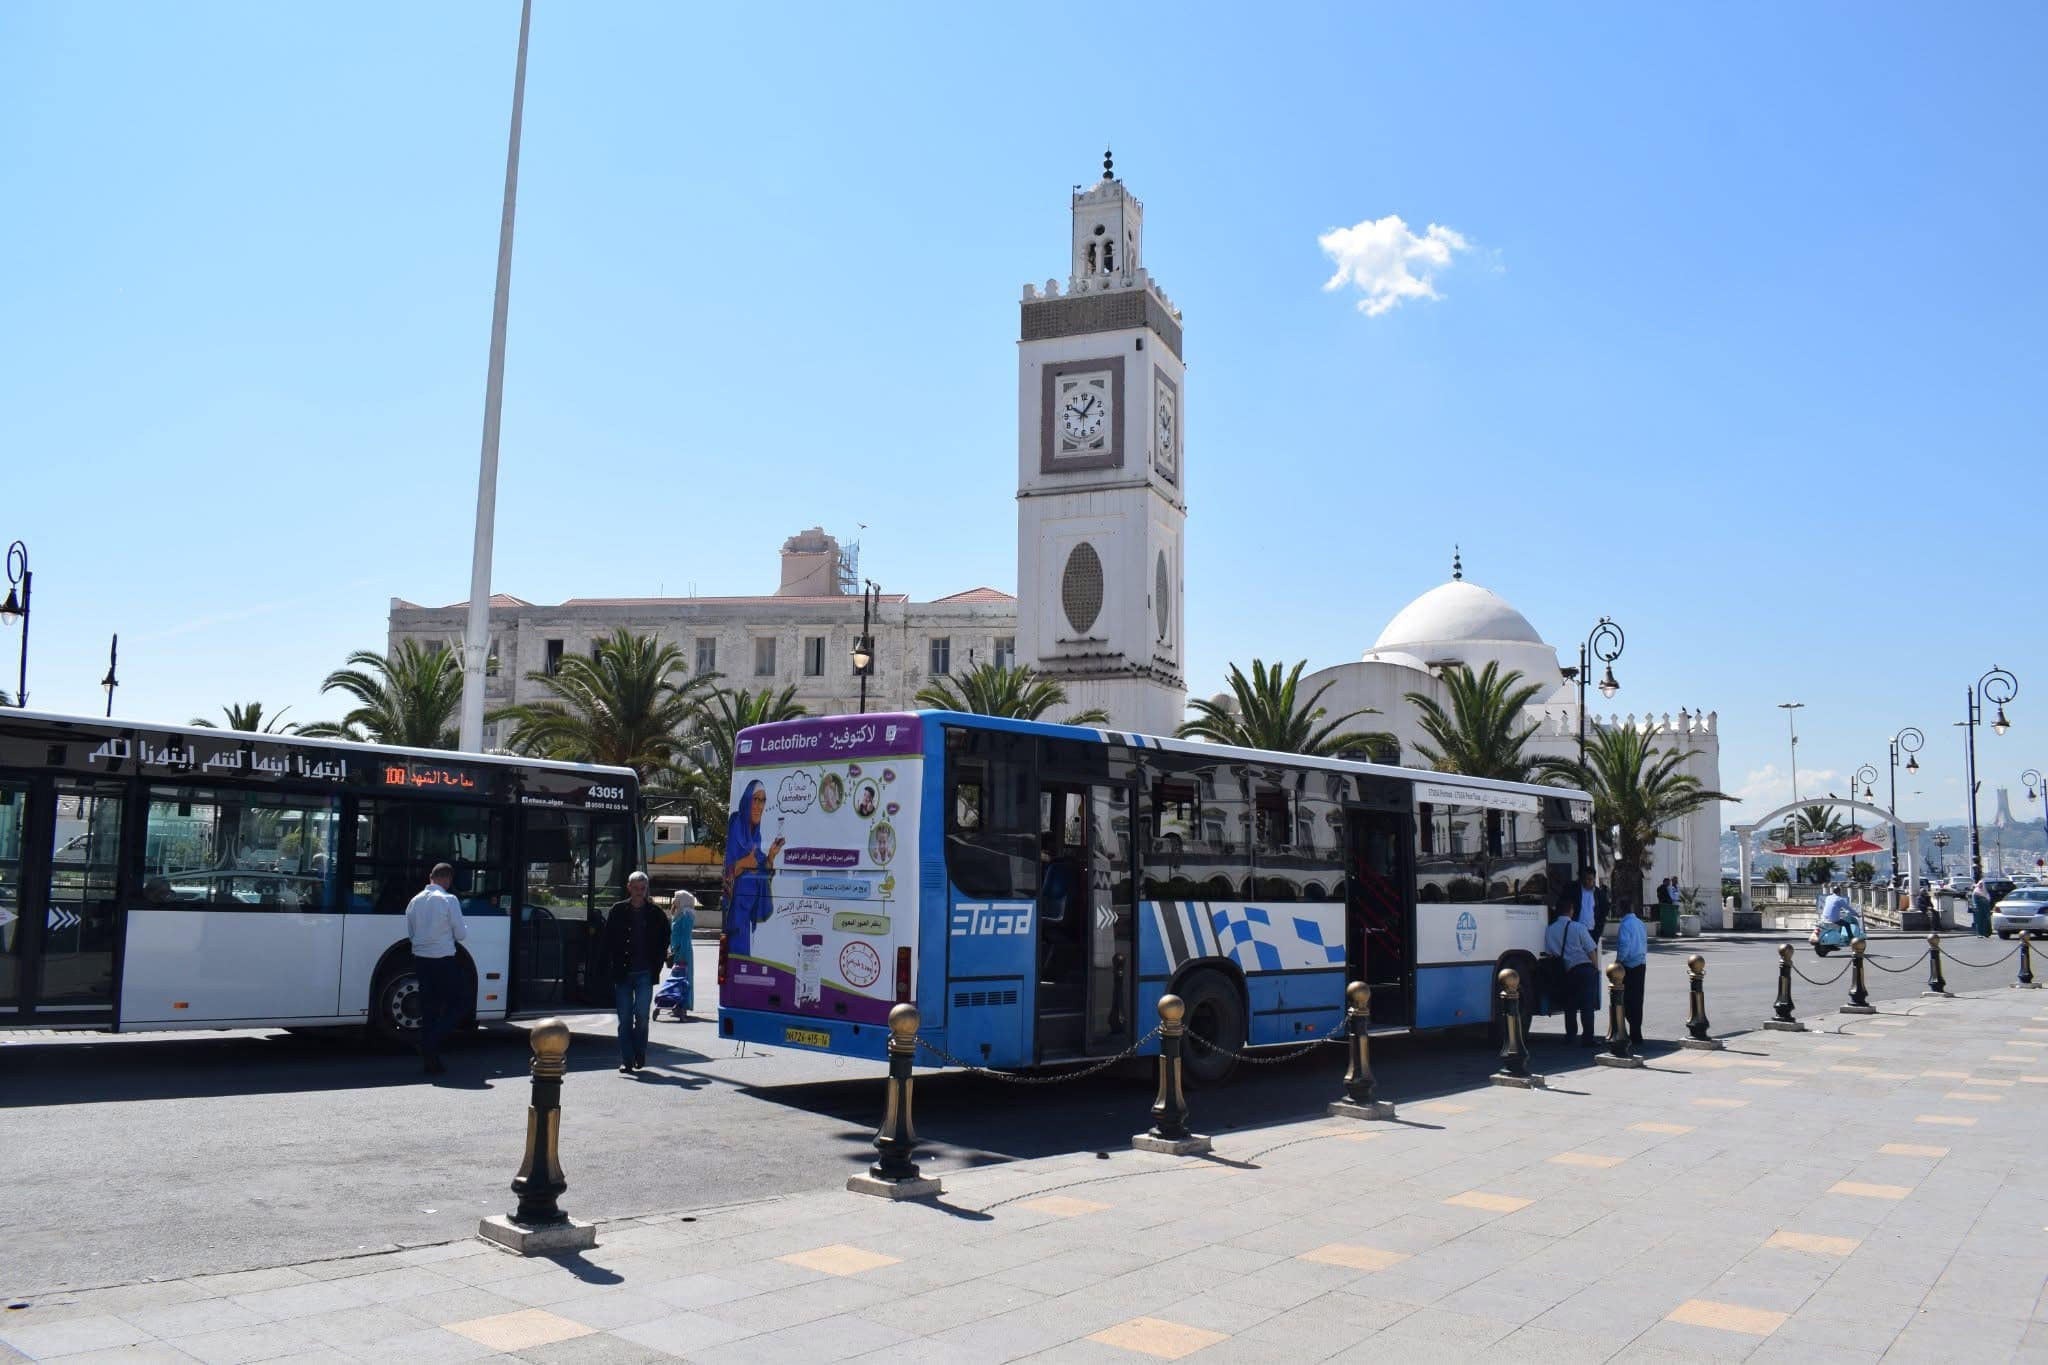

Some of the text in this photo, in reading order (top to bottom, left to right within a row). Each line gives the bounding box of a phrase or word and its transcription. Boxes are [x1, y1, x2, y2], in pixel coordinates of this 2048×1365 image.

[760, 733, 818, 752] Lactofibre
[829, 724, 876, 750] لاكتوفيبر
[88, 738, 347, 782] إيتوزا أينما كنتم إيتوزا لكم
[385, 768, 405, 784] 100
[588, 785, 624, 800] 43051
